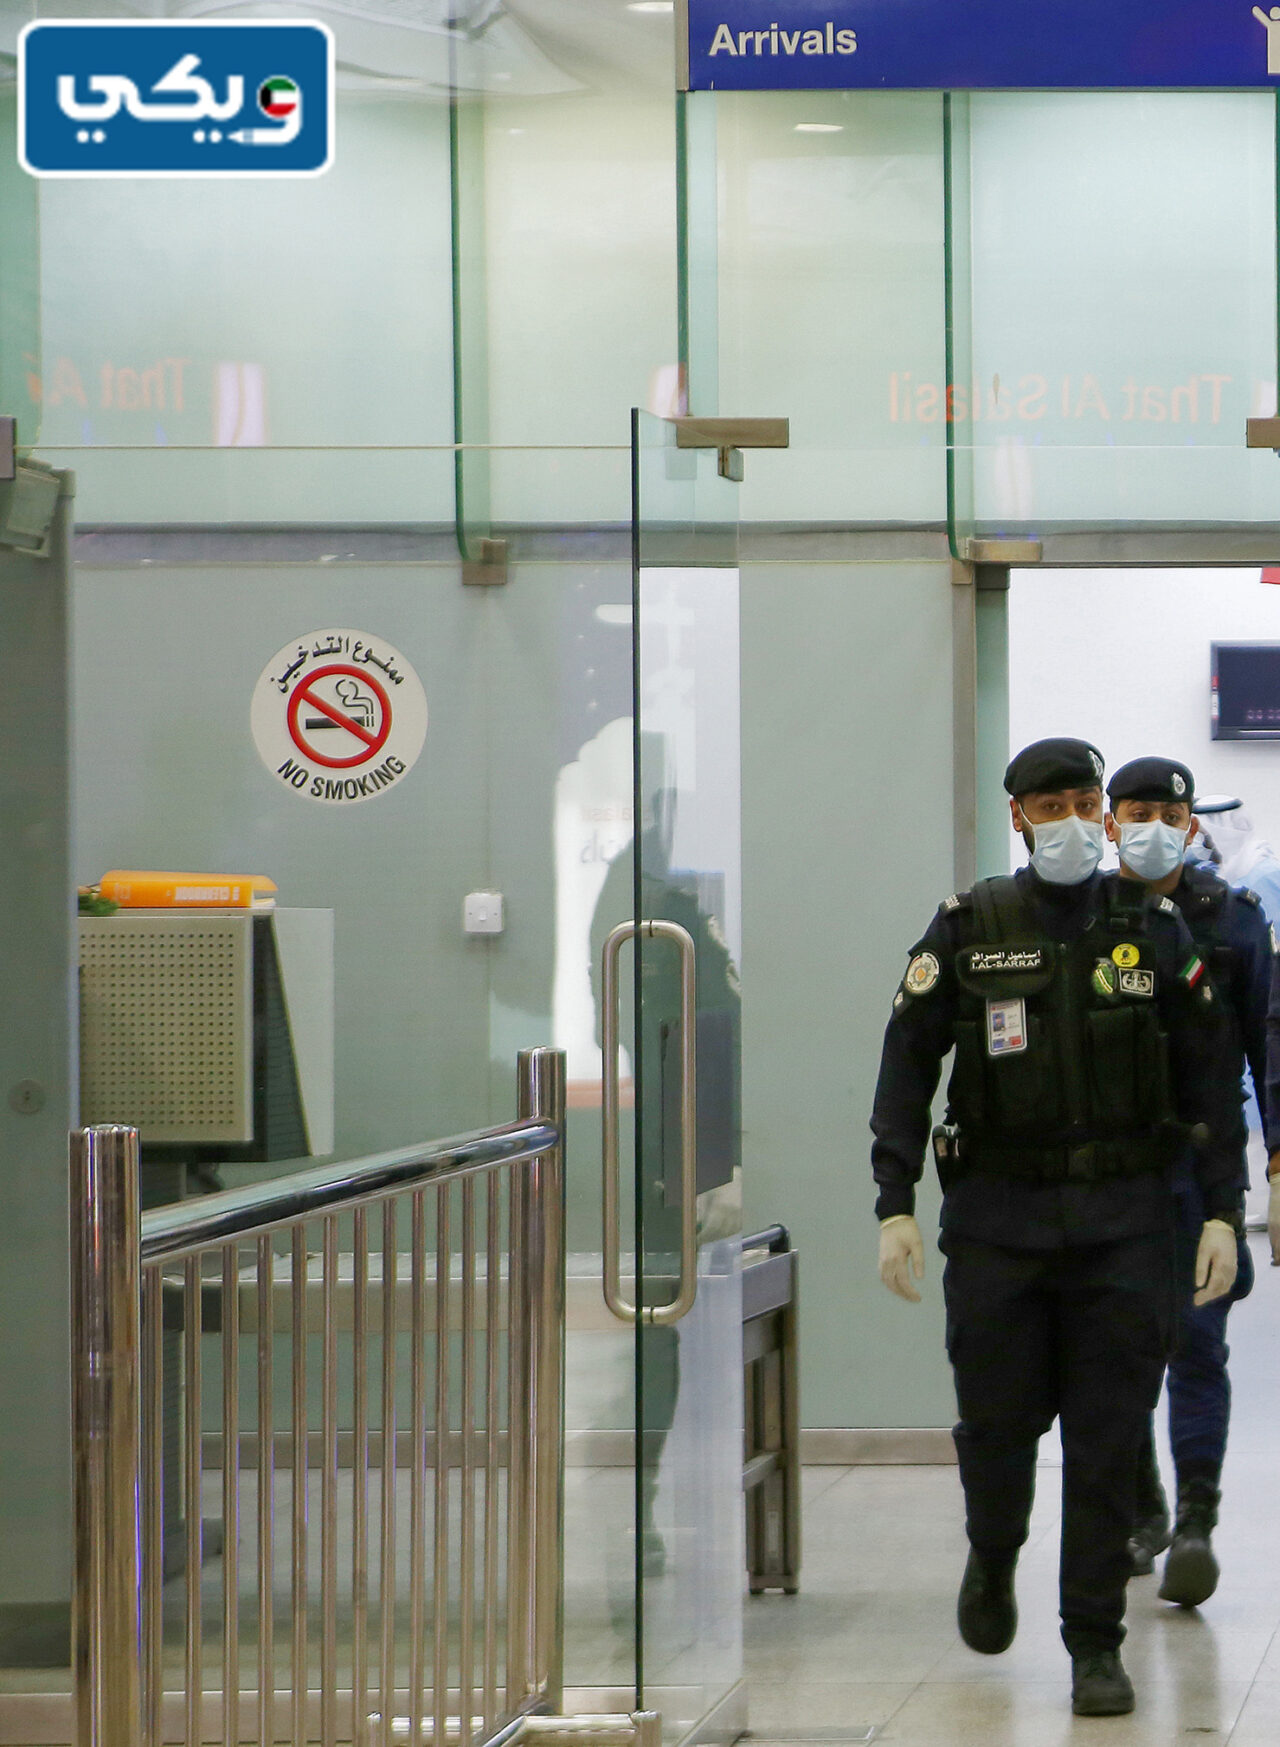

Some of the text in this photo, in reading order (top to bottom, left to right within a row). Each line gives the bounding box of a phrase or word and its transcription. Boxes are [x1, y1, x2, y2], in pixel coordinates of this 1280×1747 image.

[708, 21, 857, 56] Arrivals
[270, 636, 404, 694] ممنوع التدخين
[277, 755, 407, 800] NO SMOKING
[971, 958, 1041, 970] I.AL-SARRAF
